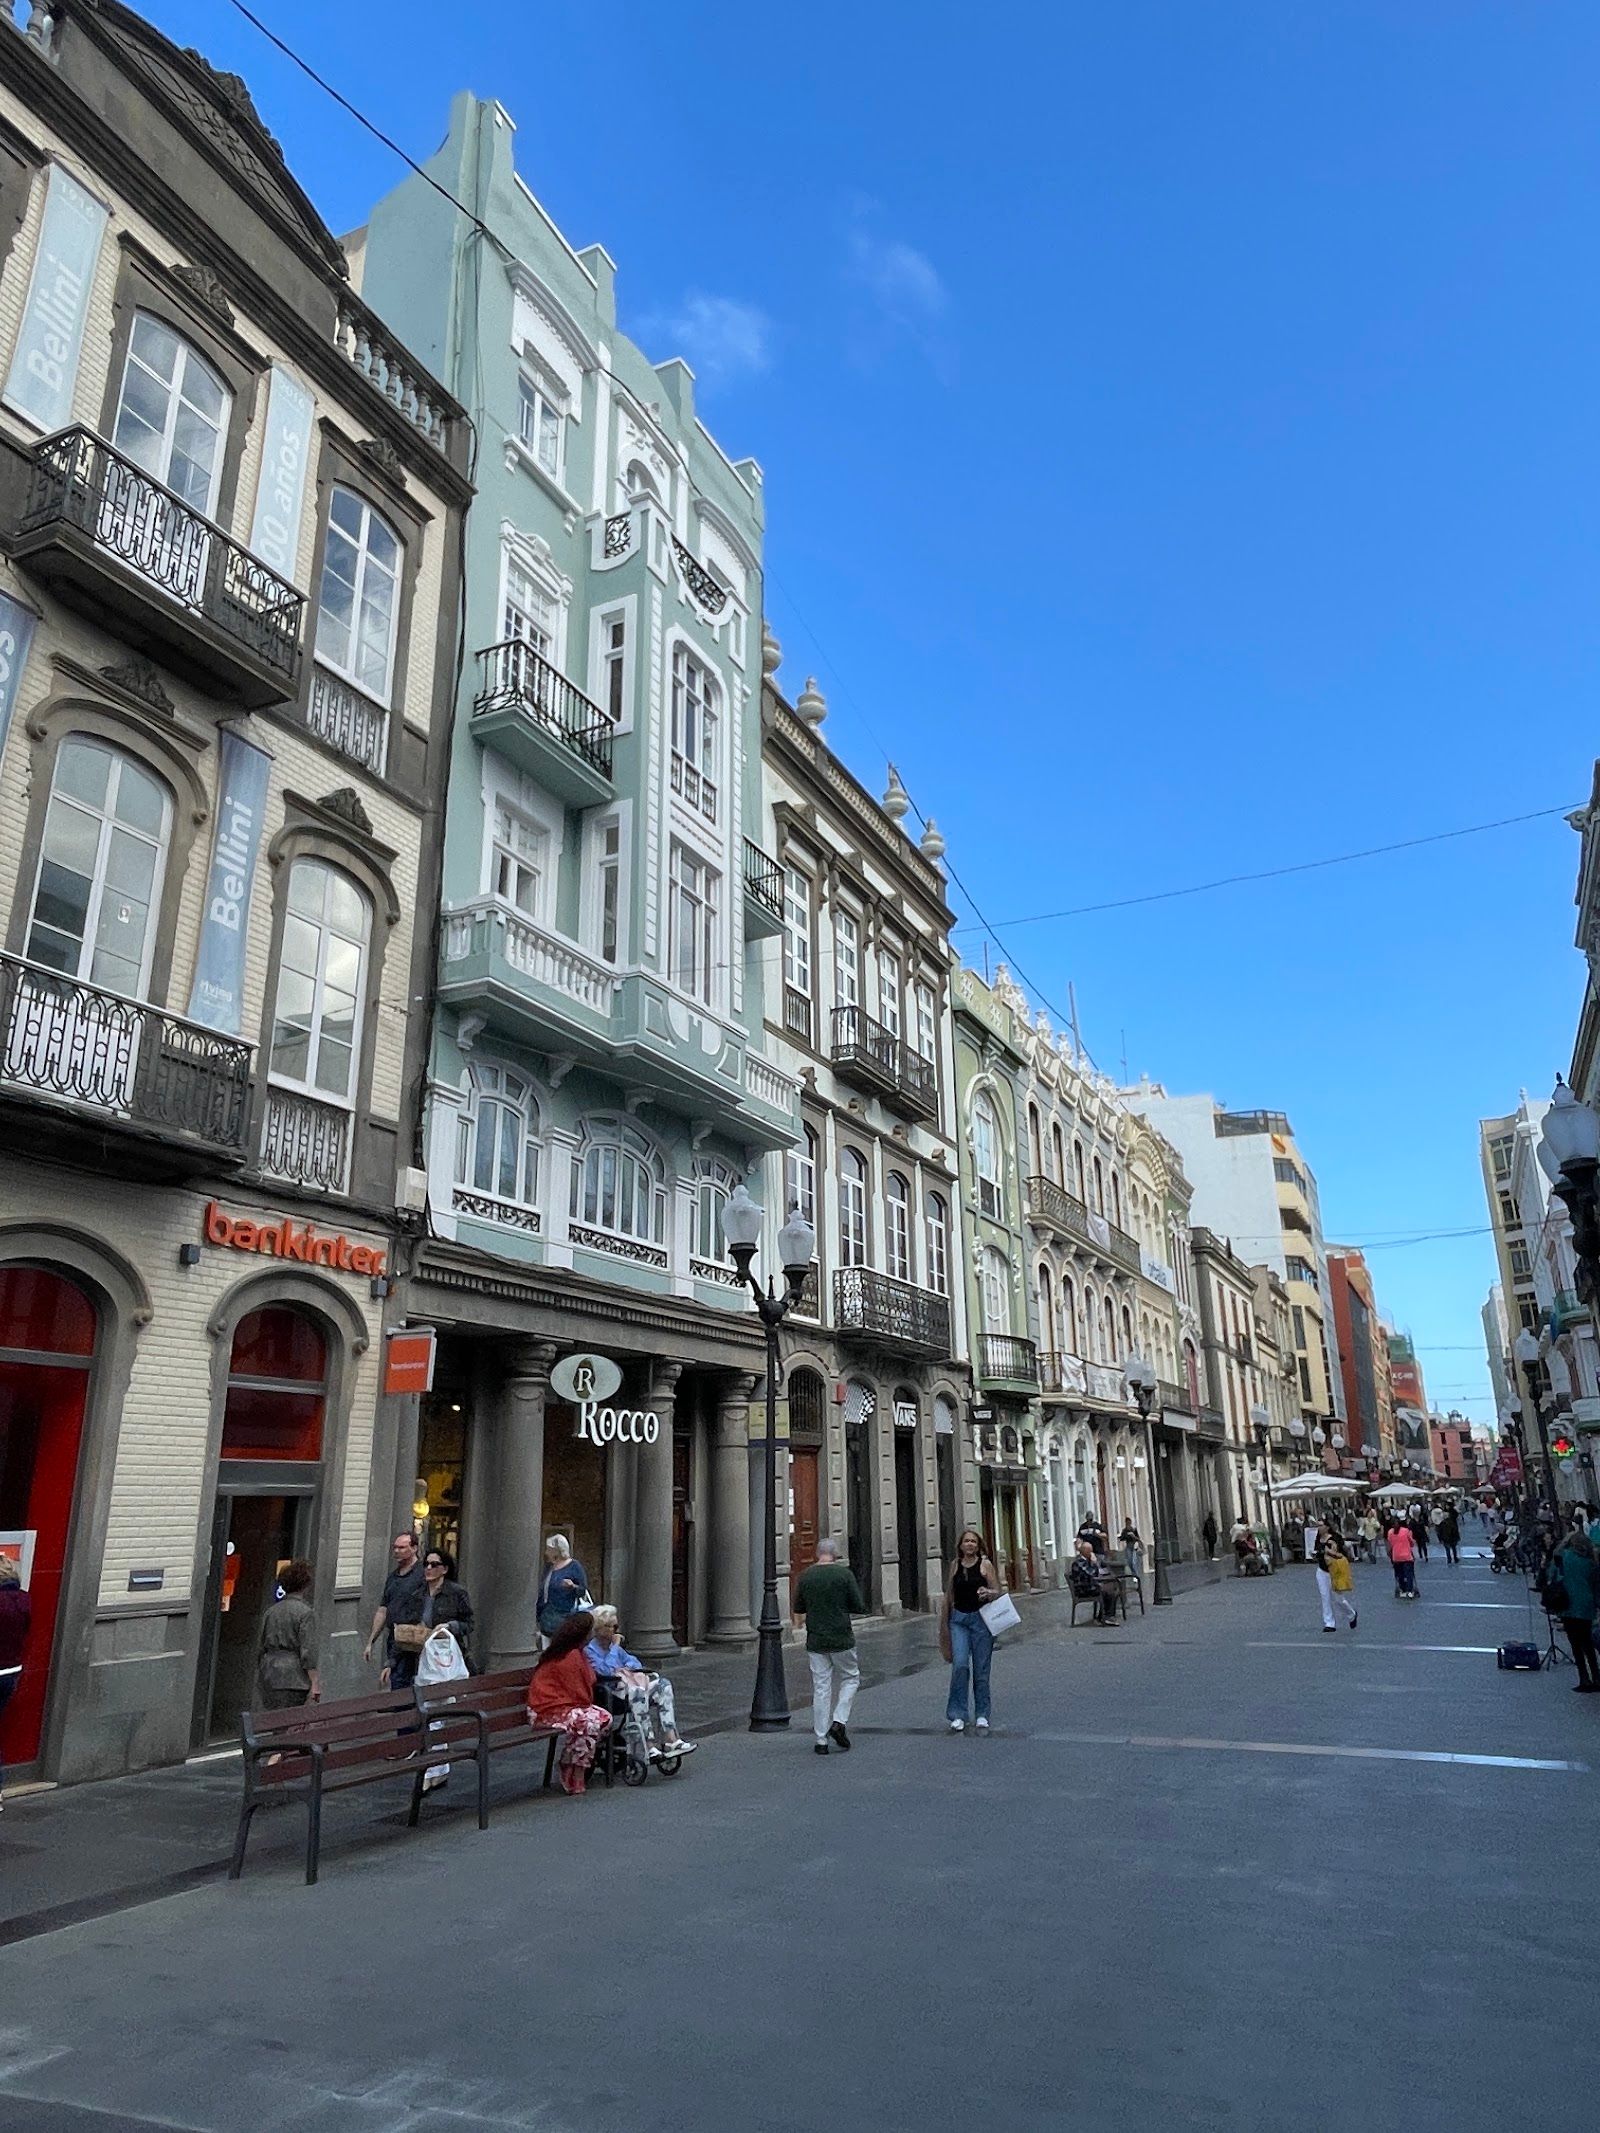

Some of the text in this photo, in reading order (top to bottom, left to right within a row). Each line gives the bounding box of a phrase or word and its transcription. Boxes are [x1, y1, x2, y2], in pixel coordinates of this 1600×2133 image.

[28, 252, 82, 392] Bellini
[270, 427, 299, 513] años
[210, 796, 252, 932] Bellini
[577, 1367, 597, 1395] R
[892, 1401, 917, 1428] VANS
